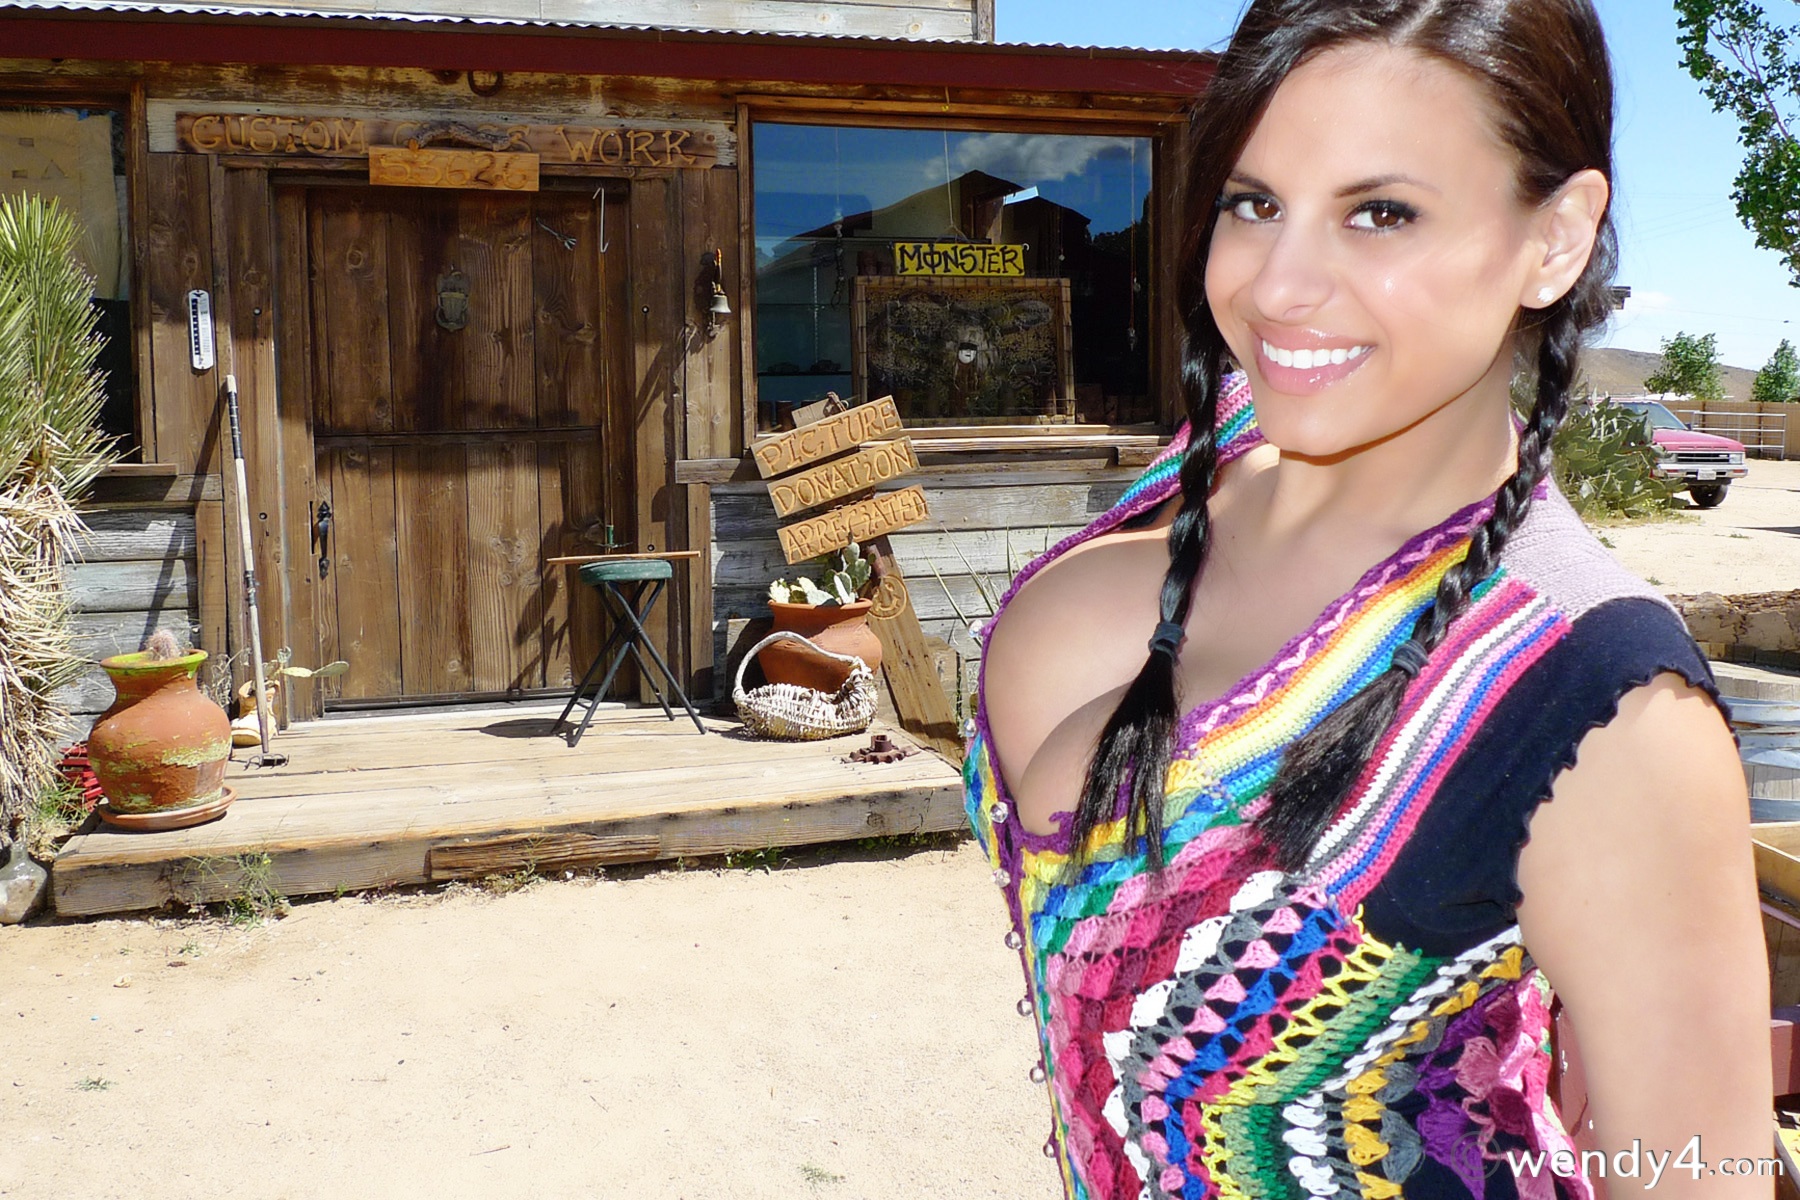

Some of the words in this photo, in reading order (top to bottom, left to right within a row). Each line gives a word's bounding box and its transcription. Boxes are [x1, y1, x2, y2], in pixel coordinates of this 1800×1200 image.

[192, 116, 369, 154] CUSTOM
[555, 125, 697, 165] WORK
[897, 244, 1023, 275] MONSTER
[756, 400, 900, 475] PICTURE
